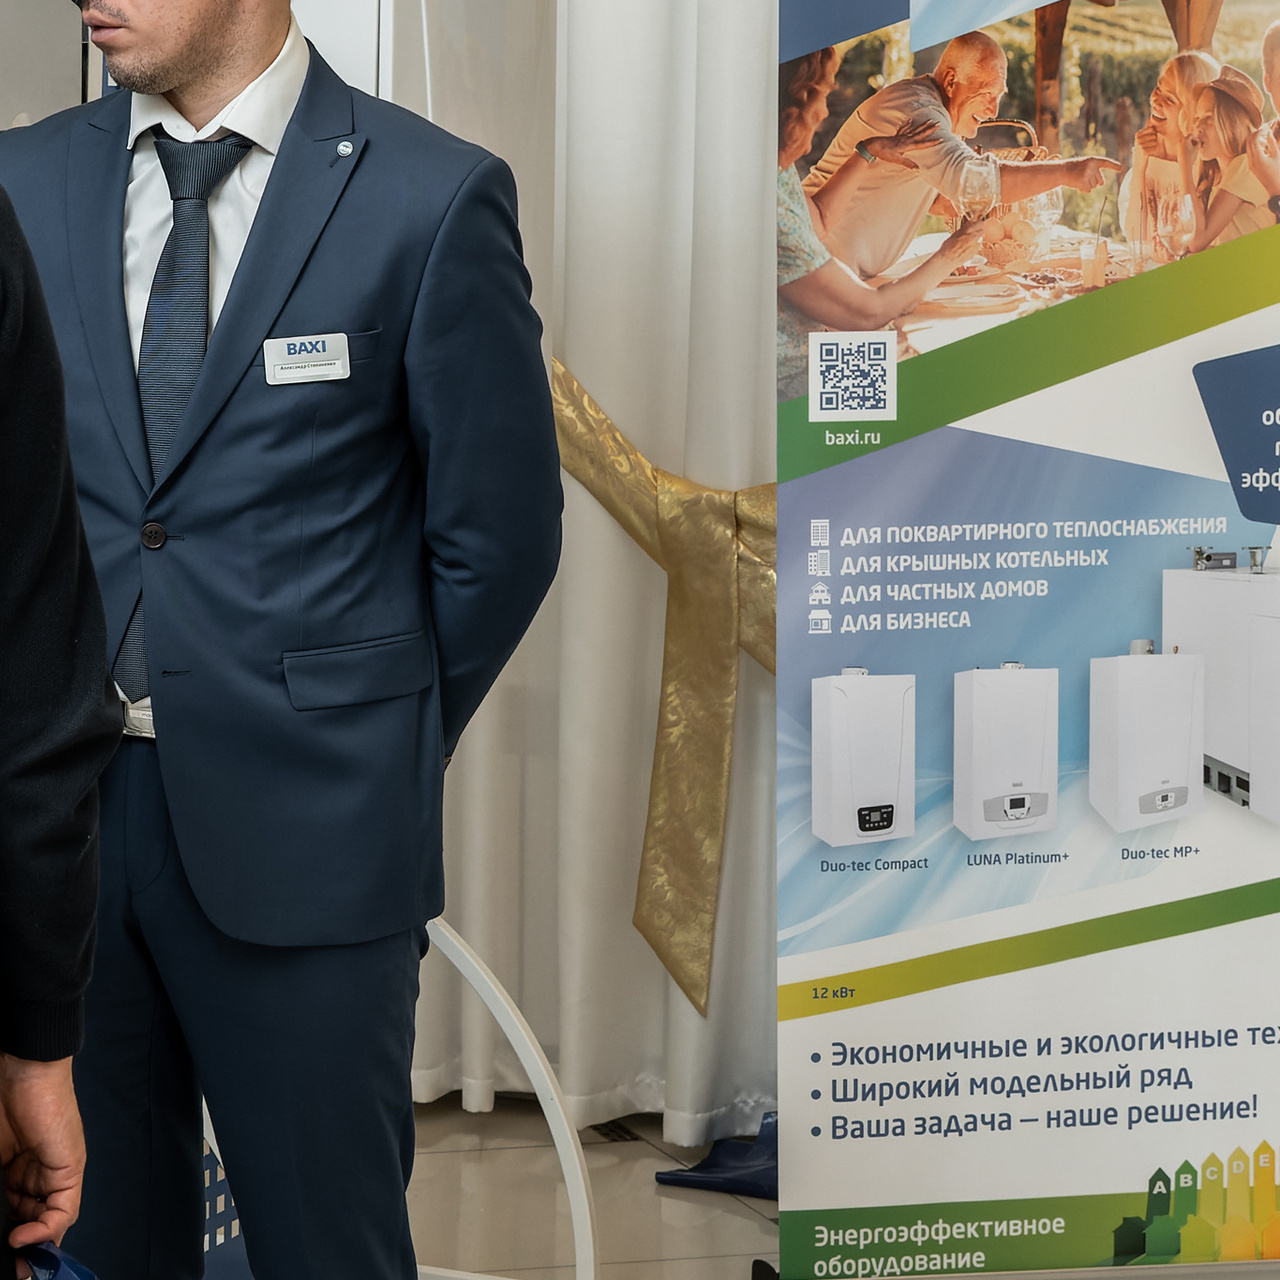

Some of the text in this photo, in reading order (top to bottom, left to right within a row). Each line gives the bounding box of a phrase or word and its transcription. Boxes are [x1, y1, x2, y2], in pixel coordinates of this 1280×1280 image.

[287, 340, 326, 355] BAXI
[825, 429, 881, 446] baxi.ru
[840, 517, 1228, 546] ДЛЯ ПОКВАРТИРНОГО ТЕПЛОСНАБЖЕНИЯ
[840, 549, 1110, 576] ДЛЯ КРЫШНЫХ КОТЕЛЬНЫХ
[840, 580, 1049, 605] ДЛЯ ЧАСТНЫХ ДОМОВ
[840, 611, 972, 634] ДЛЯ БИЗНЕСА
[820, 857, 930, 873] Duo-tec Compact
[966, 851, 1070, 866] LUNA Platinum+
[1120, 845, 1201, 861] Duo-tec MP+
[812, 986, 856, 999] 12 кВт
[831, 1037, 1028, 1067] Экономичные
[1037, 1037, 1052, 1056] и
[1060, 1028, 1239, 1055] экологичные
[831, 1063, 1194, 1107] Широкий модельный ряд
[831, 1115, 906, 1141] Ваша
[914, 1109, 1013, 1137] задача
[1046, 1104, 1119, 1129] наше
[1128, 1095, 1259, 1131] решение!
[1152, 1154, 1271, 1194] A B C D E
[814, 1216, 1066, 1250] Энергоэффективное
[813, 1251, 986, 1279] оборудование
